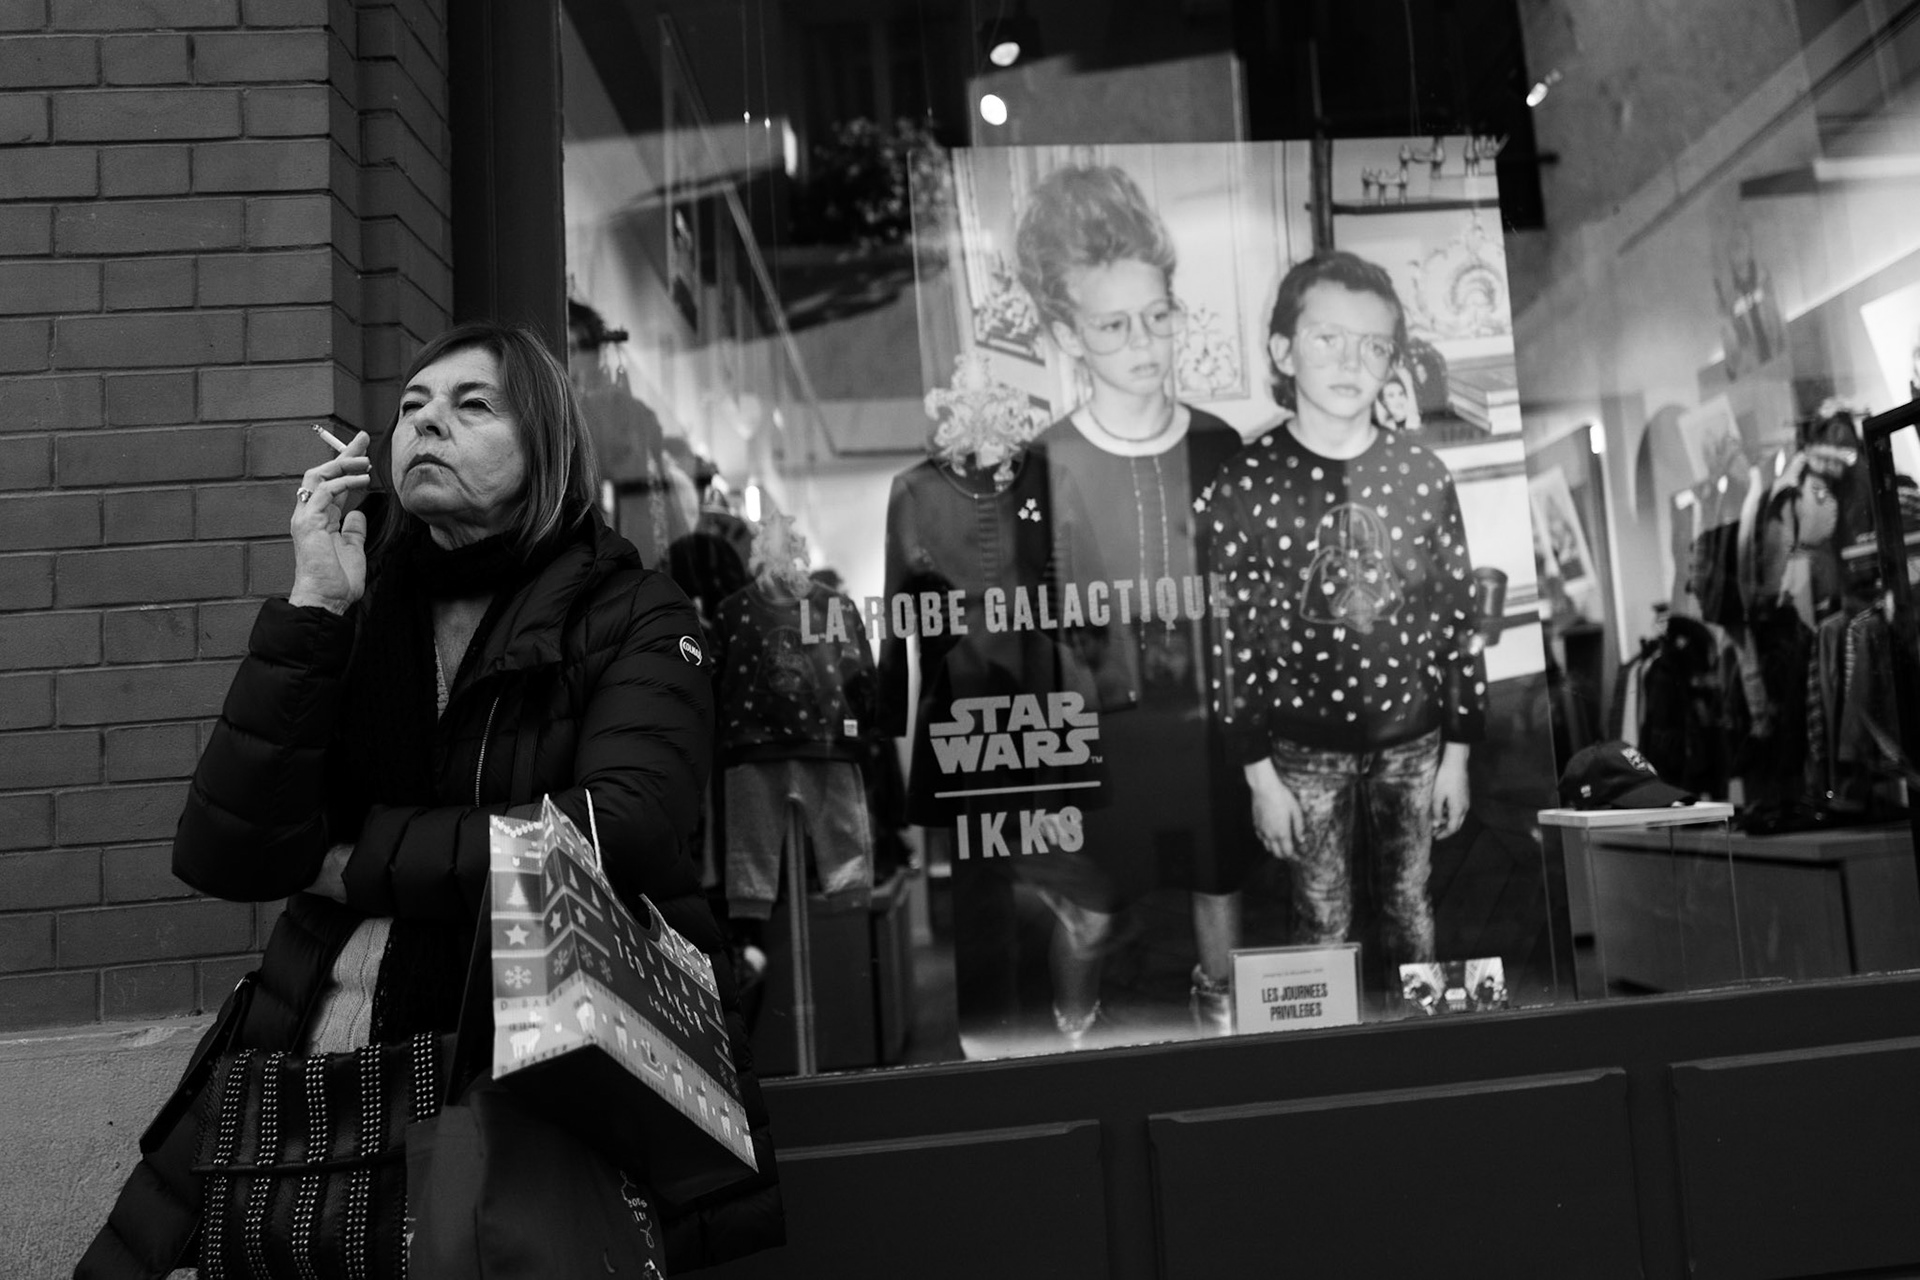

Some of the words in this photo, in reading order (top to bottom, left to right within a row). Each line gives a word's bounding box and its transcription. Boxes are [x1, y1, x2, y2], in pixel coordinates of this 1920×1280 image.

[801, 596, 847, 645] LA
[864, 590, 969, 641] ROBE
[984, 572, 1230, 634] GALACTIQUE
[929, 691, 1099, 737] STAR
[930, 727, 1100, 774] WARS
[957, 805, 1084, 860] IKKS
[614, 934, 645, 979] TED
[1262, 986, 1279, 1003] LES
